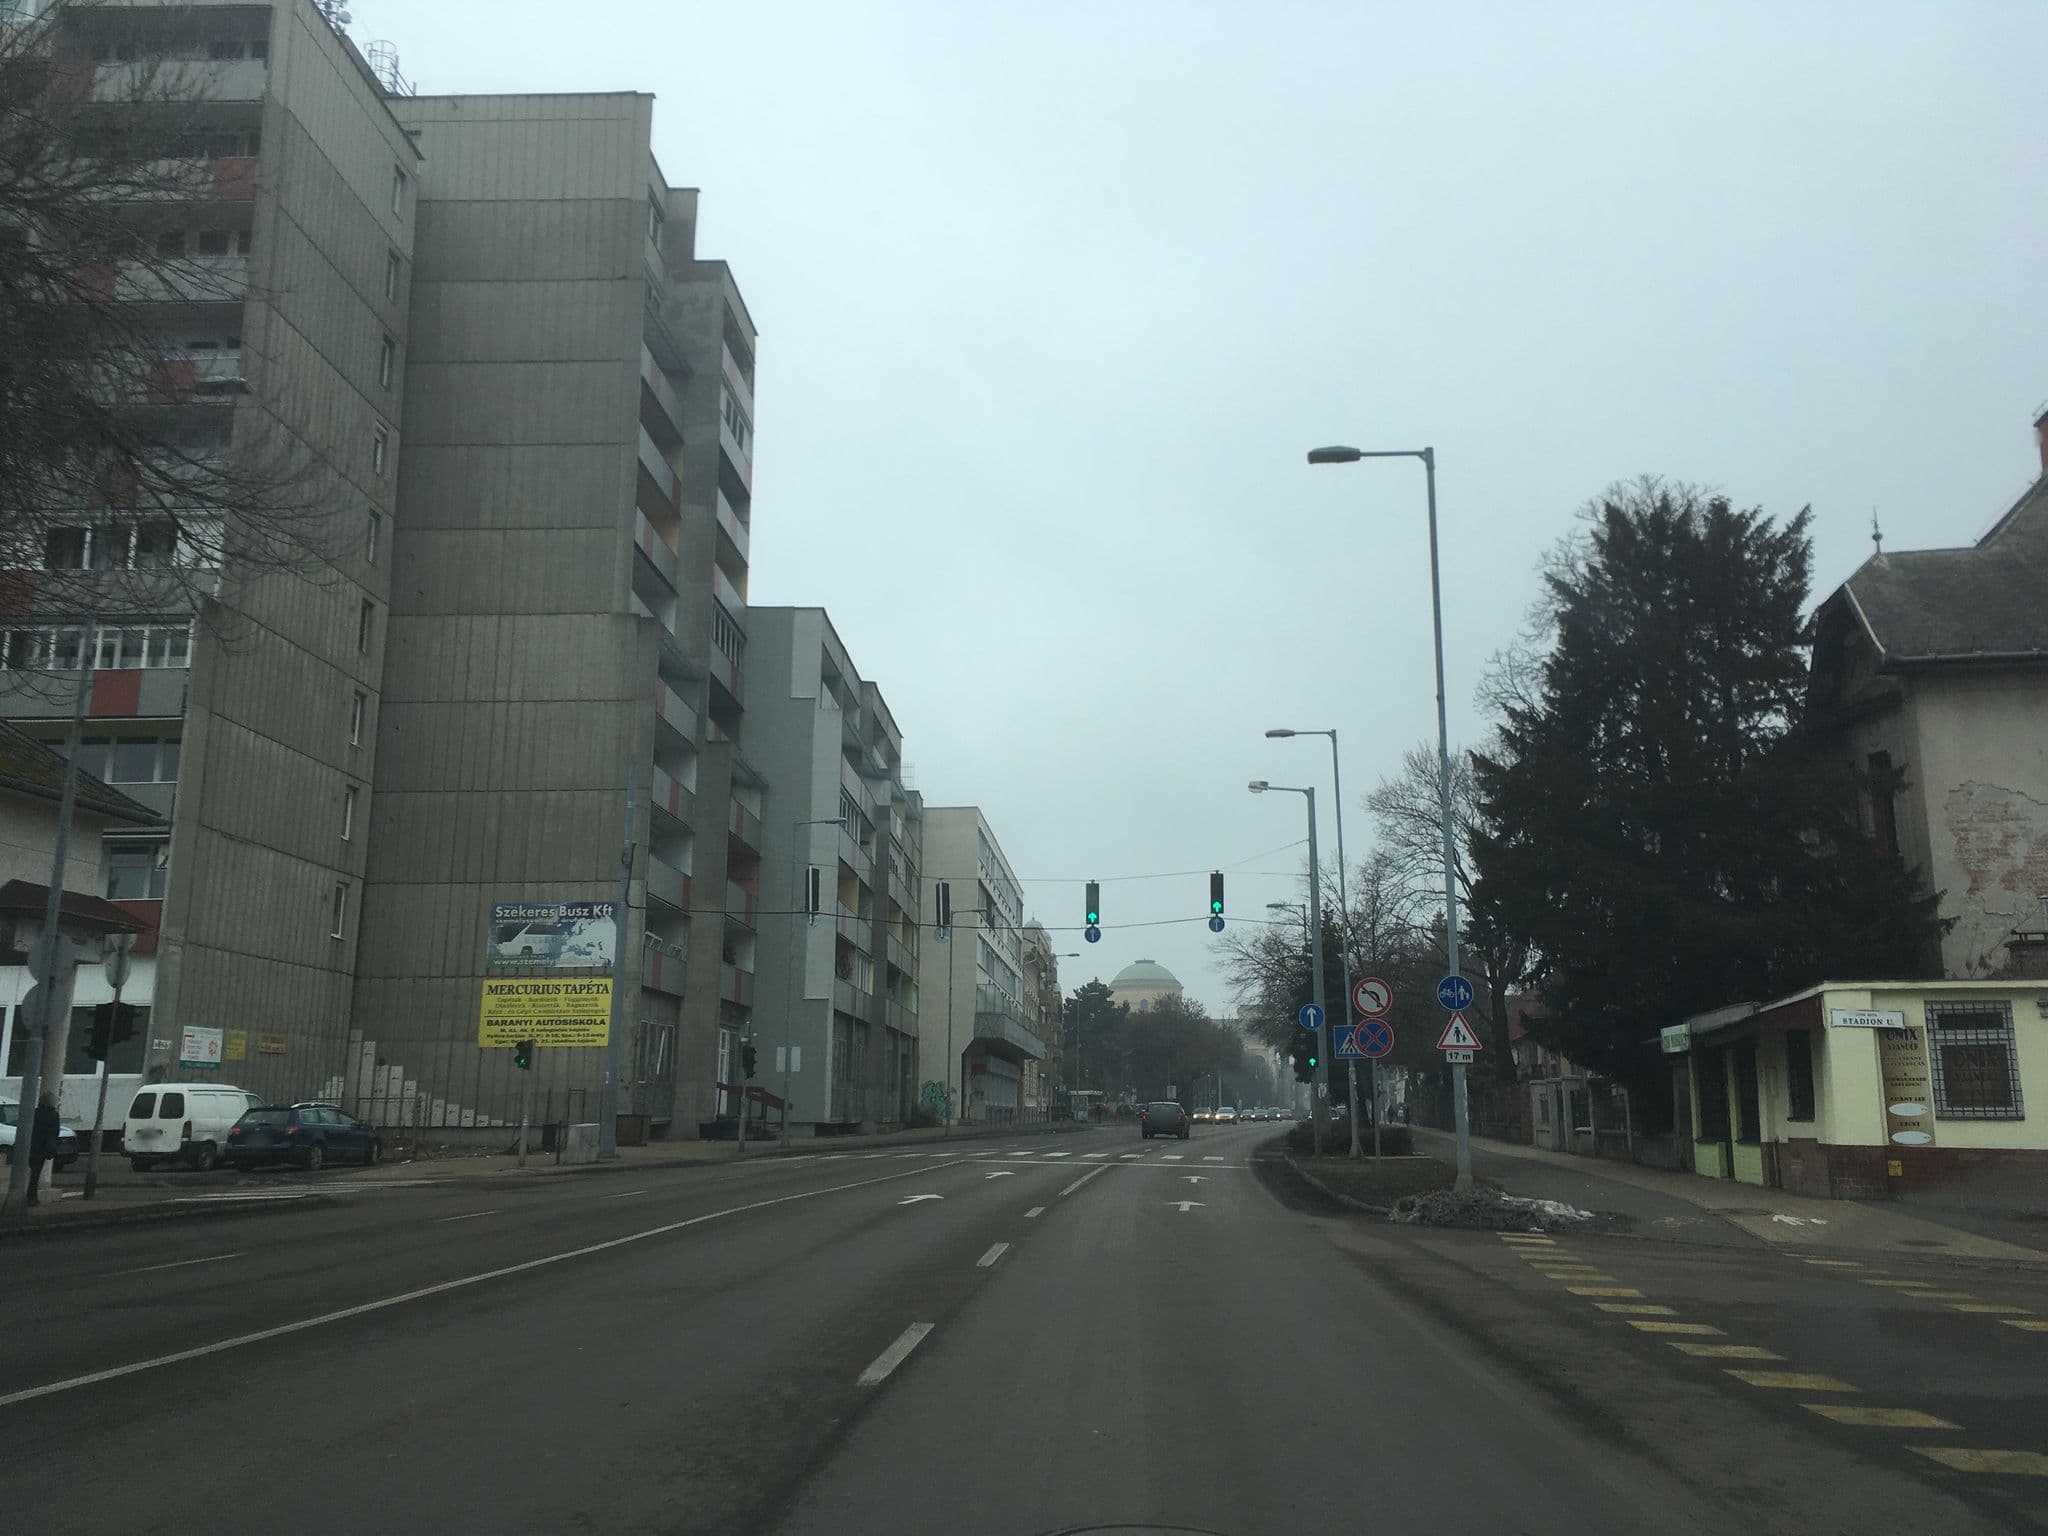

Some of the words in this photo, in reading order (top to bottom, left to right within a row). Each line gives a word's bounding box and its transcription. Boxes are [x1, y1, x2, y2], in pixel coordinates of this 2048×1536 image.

[495, 905, 556, 917] Szekeres
[559, 906, 589, 917] Busz
[593, 904, 613, 916] Kft
[487, 984, 561, 995] MERCURIUS
[562, 980, 610, 995] TAPÉTA
[1448, 1052, 1459, 1060] 17
